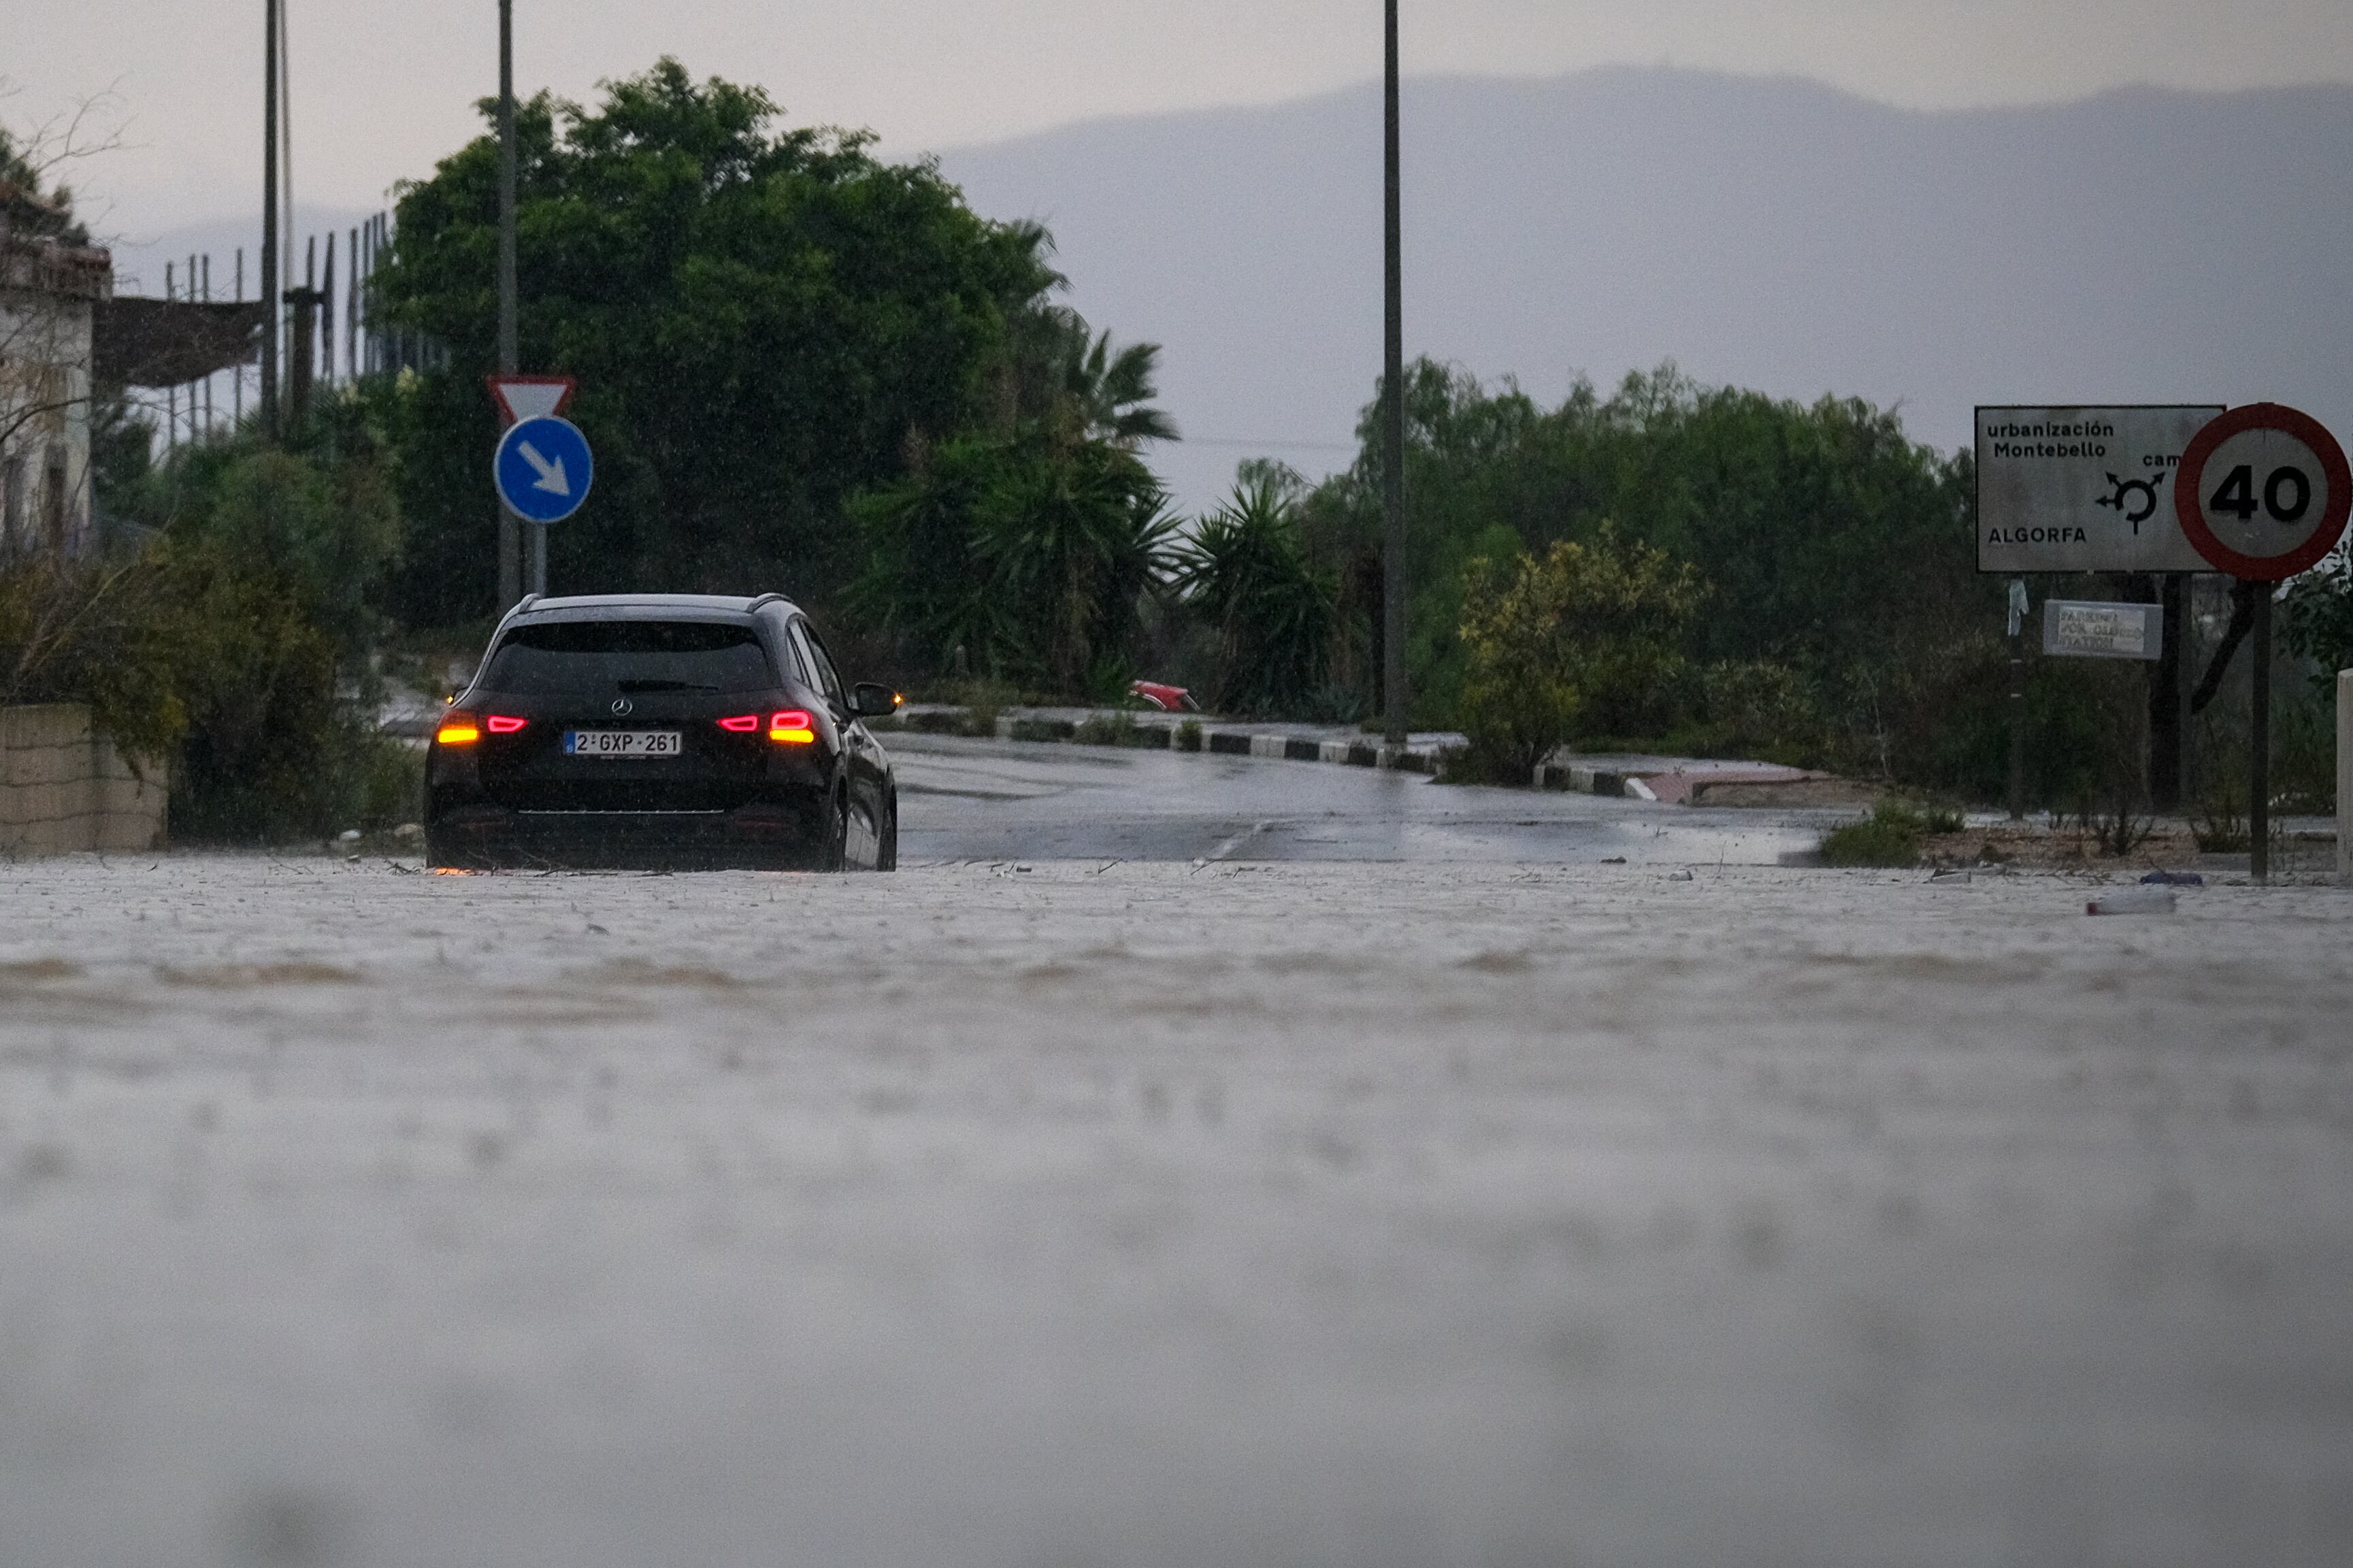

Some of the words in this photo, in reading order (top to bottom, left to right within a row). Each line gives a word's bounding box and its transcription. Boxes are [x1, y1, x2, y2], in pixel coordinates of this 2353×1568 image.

[1987, 421, 2114, 437] urbanización
[1994, 442, 2106, 458] Montebello
[2209, 464, 2311, 523] 40
[1988, 527, 2087, 544] ALGORFA
